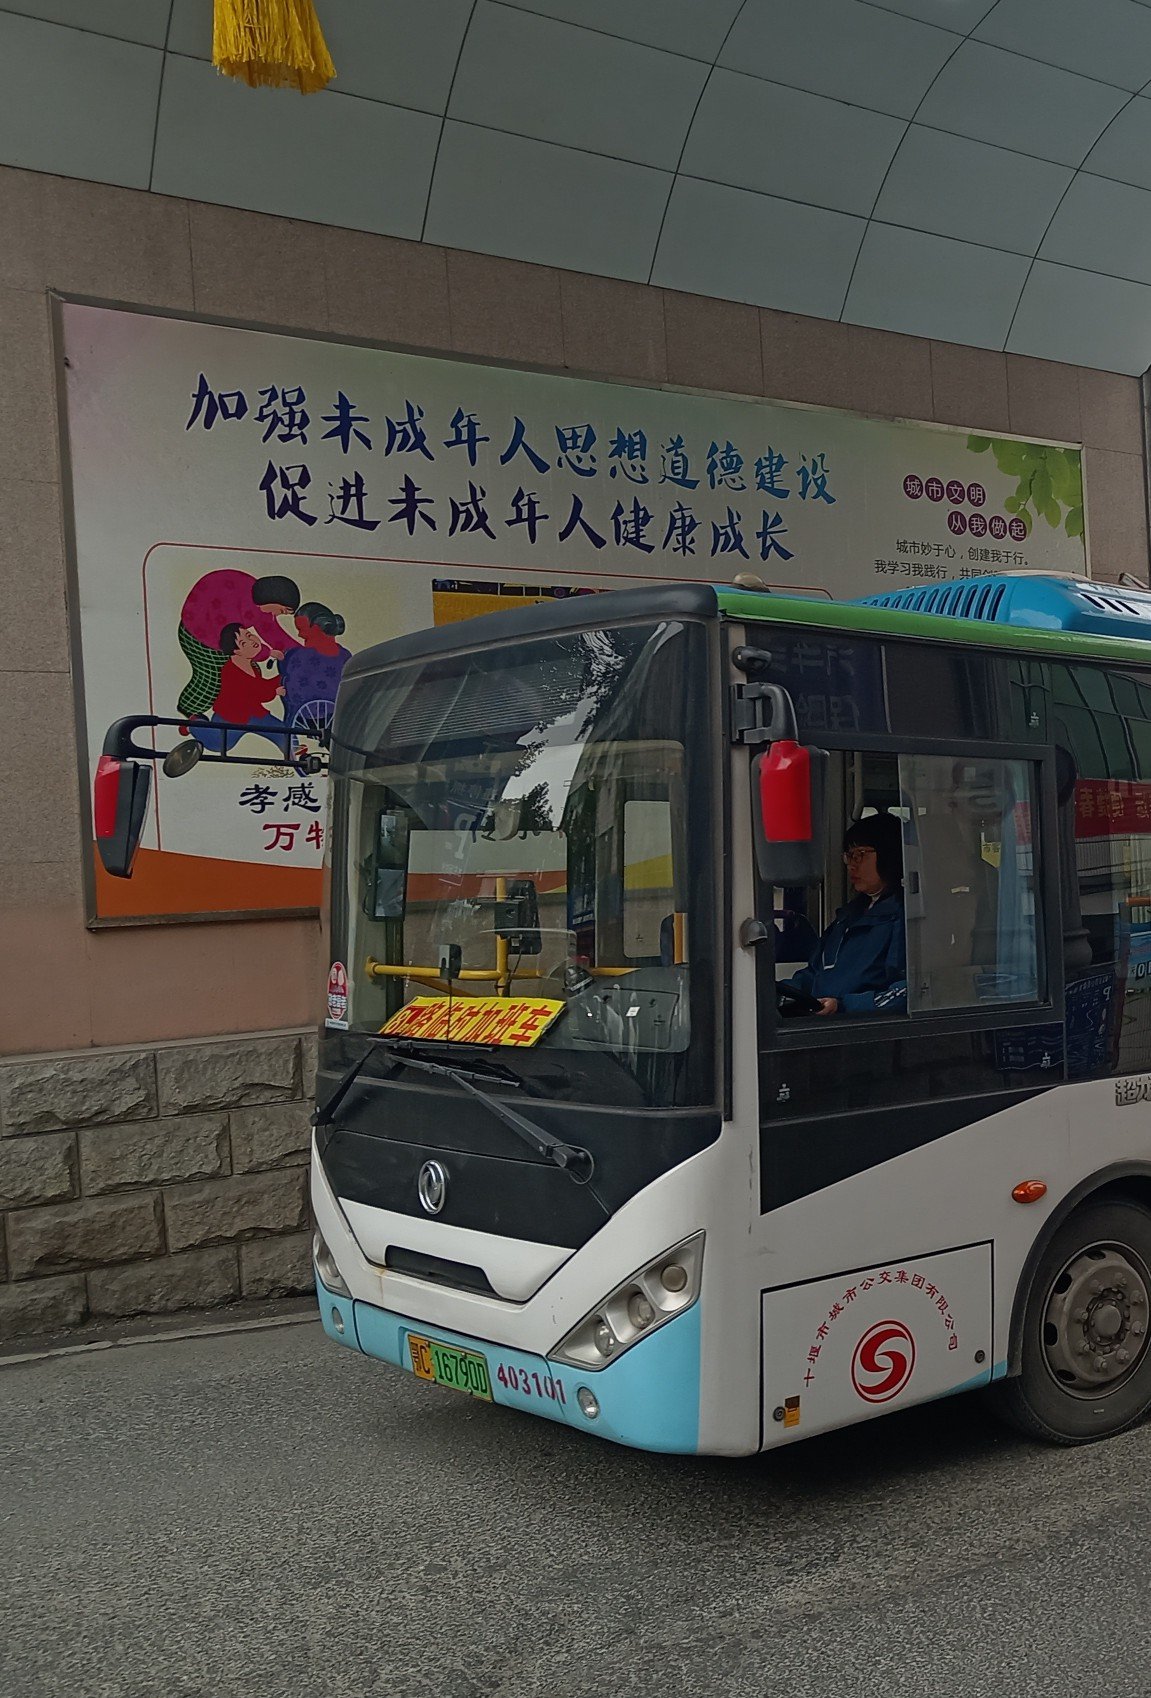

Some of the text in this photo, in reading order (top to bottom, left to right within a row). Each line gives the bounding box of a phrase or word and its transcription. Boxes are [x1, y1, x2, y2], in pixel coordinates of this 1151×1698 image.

[185, 371, 837, 505] 加强未成年人思想道德建设
[904, 477, 985, 505] 城市文明
[258, 460, 795, 562] 促进未成年人健康成长
[948, 513, 1027, 540] 从我做起
[873, 559, 998, 581] 我学习我践行，共同
[238, 781, 322, 815] 孝感
[803, 1269, 958, 1388] 十堰市城市公交集团有限公司
[497, 1362, 567, 1405] 403101
